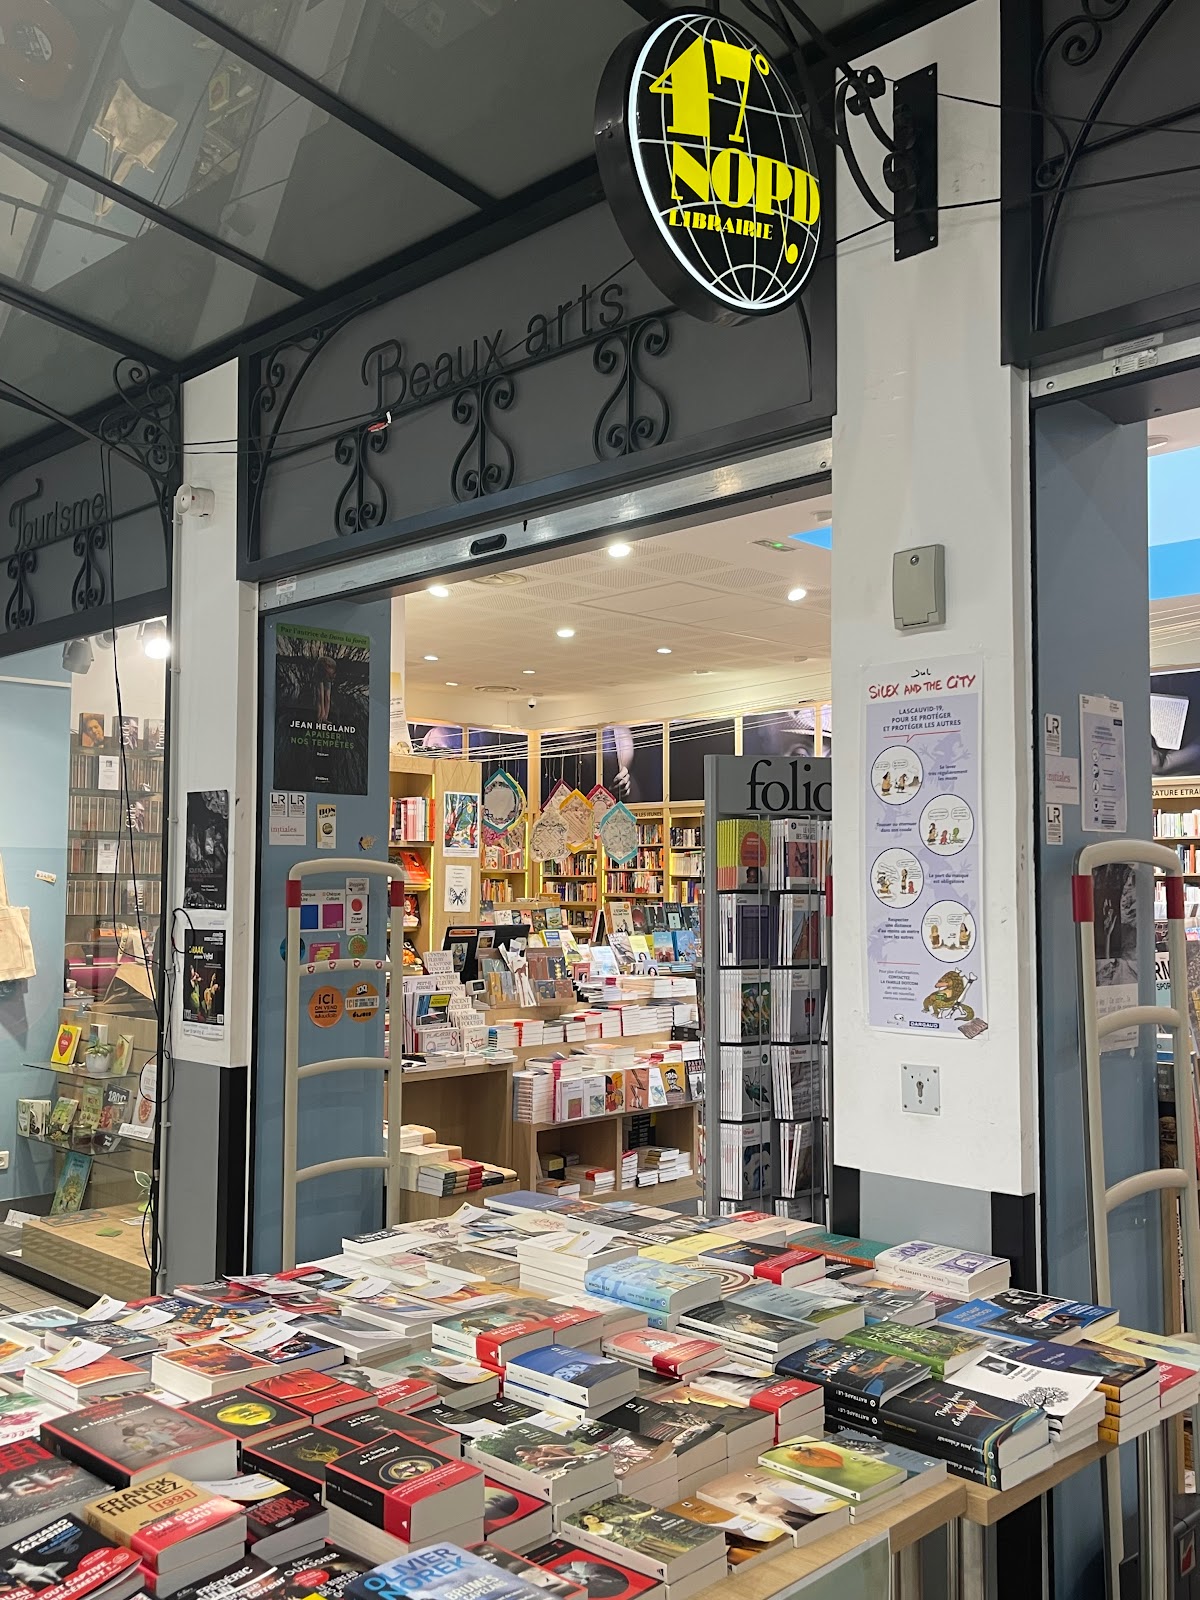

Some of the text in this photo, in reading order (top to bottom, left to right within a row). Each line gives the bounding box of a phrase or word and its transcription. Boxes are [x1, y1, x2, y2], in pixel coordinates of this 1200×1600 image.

[671, 141, 820, 230] NORD
[669, 209, 773, 240] LIBRAIRIE
[361, 284, 624, 416] Beaux arts
[9, 478, 105, 551] Tourisme
[904, 686, 922, 696] AND
[923, 680, 942, 691] THE
[290, 721, 356, 734] JEAN HEGLAND
[891, 722, 922, 731] PROTÉGER
[919, 712, 951, 721] PROTÉGER
[291, 737, 355, 749] NOS TEMPÊTES
[305, 730, 341, 740] APAISER
[96, 1476, 173, 1512] FRANCK
[102, 1481, 184, 1517] THILLIEZ
[153, 1490, 194, 1510] 1991
[11, 1518, 69, 1551] FABIANO
[18, 1521, 74, 1554] MASSIMI
[152, 1520, 174, 1532] UN
[196, 1566, 254, 1597] FRÉDÉRIC
[363, 1547, 457, 1592] OLIVIER
[378, 1555, 476, 1600] NOREK
[444, 1574, 500, 1600] BRUMES
